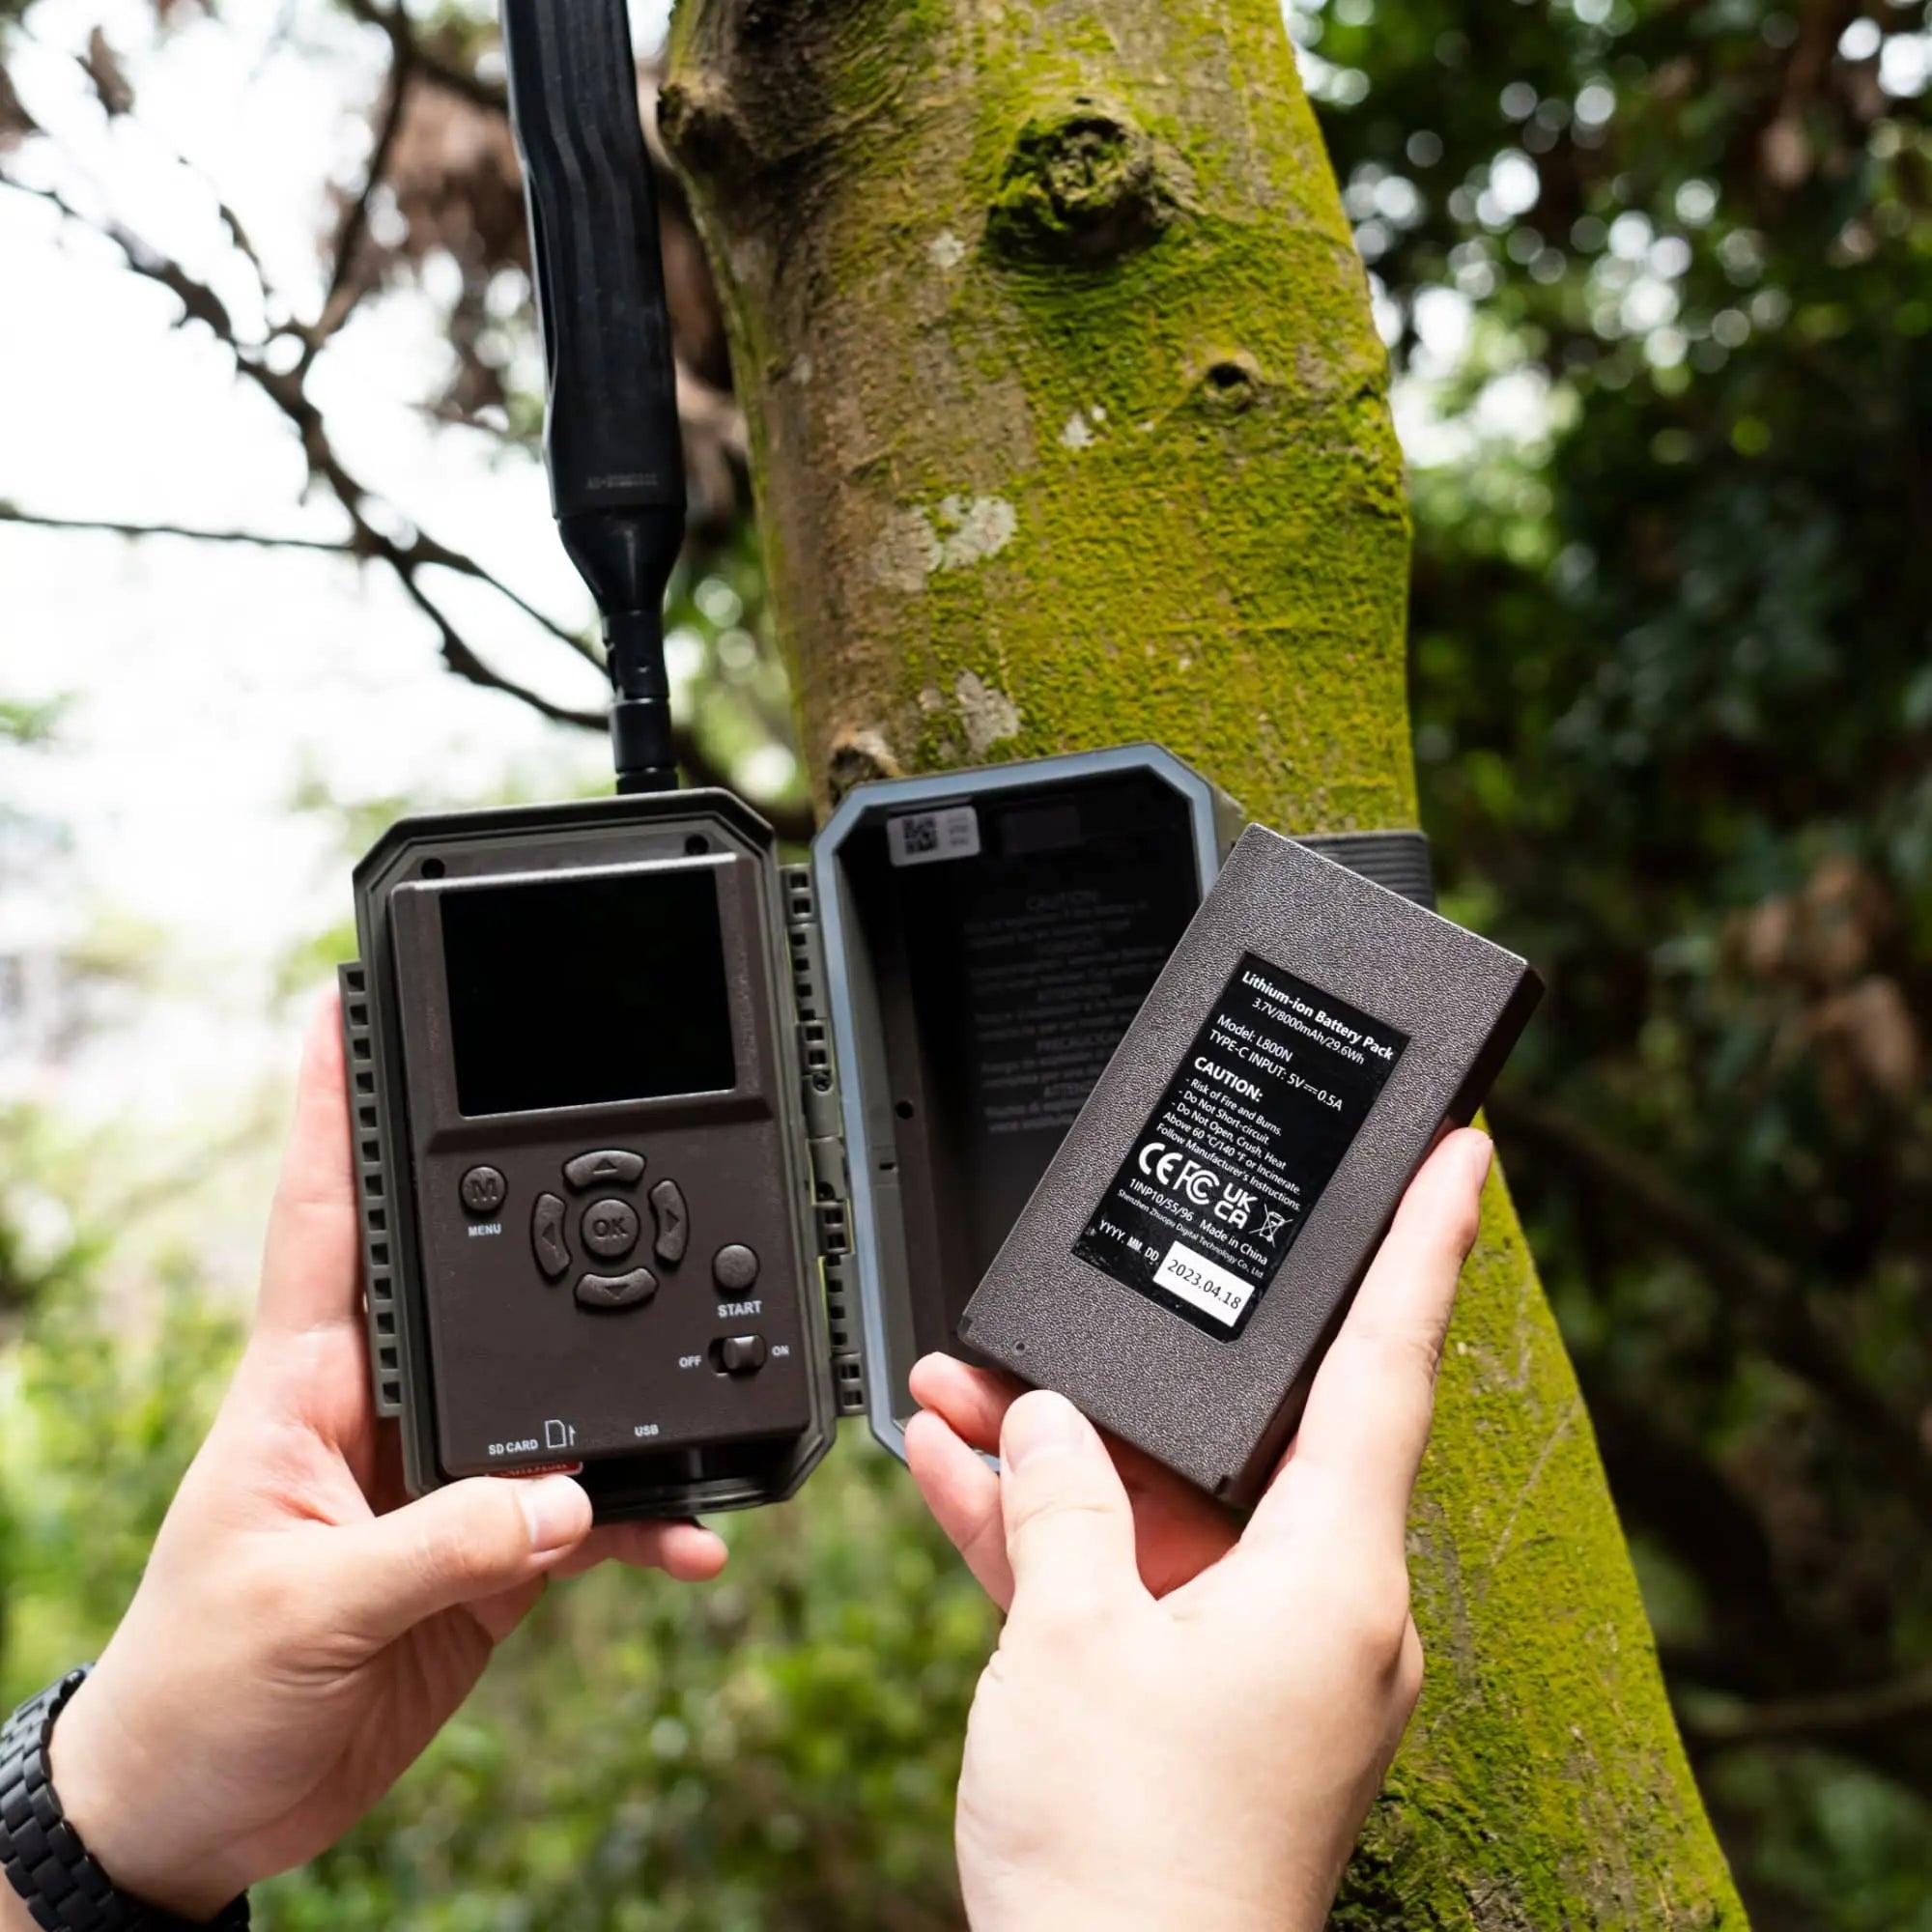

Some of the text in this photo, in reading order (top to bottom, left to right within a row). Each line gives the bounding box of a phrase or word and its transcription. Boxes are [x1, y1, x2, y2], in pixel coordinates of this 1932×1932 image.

[1216, 1013, 1293, 1062] Model: L800N
[1241, 971, 1394, 1061] Lithium-ion Battery Pack
[1251, 997, 1364, 1064] 3.7V/8000mAh/29.6Wh
[1209, 1029, 1249, 1058] TYPE-C
[1247, 1051, 1286, 1079] INPUT:
[1182, 1089, 1198, 1104] Do
[1198, 1096, 1216, 1115] Not
[1194, 1056, 1263, 1102] CAUTION:
[1190, 1077, 1210, 1095] Risk
[1209, 1090, 1223, 1100] of
[1220, 1094, 1237, 1111] Fire
[1236, 1105, 1257, 1121] and
[1255, 1115, 1284, 1138] Burns.
[1162, 1110, 1192, 1133] Above
[1192, 1126, 1206, 1140] 60
[1244, 1158, 1258, 1169] or
[1256, 1163, 1302, 1195] Incinerate.
[1176, 1100, 1191, 1116] Do
[1190, 1109, 1209, 1126] Not
[1208, 1120, 1234, 1143] Open,
[1236, 1135, 1263, 1159] Crush,
[1264, 1151, 1287, 1170] Heat
[1138, 1142, 1182, 1184] CE
[1155, 1122, 1302, 1211] Follow Manufacturer's Instructions.
[468, 1223, 502, 1237] MENU
[592, 1218, 629, 1240] OK
[1118, 1187, 1151, 1212] Shenzhen
[1176, 1221, 1200, 1241] Digital
[1199, 1236, 1236, 1264] Technology
[1129, 1178, 1268, 1265] 1INP10/55/96 Made in China
[1167, 1259, 1241, 1309] 2023.04.18
[717, 1300, 762, 1319] START
[678, 1354, 702, 1369] OFF
[771, 1345, 790, 1357] ON
[488, 1438, 539, 1456] SD CARD
[634, 1424, 660, 1437] USB
